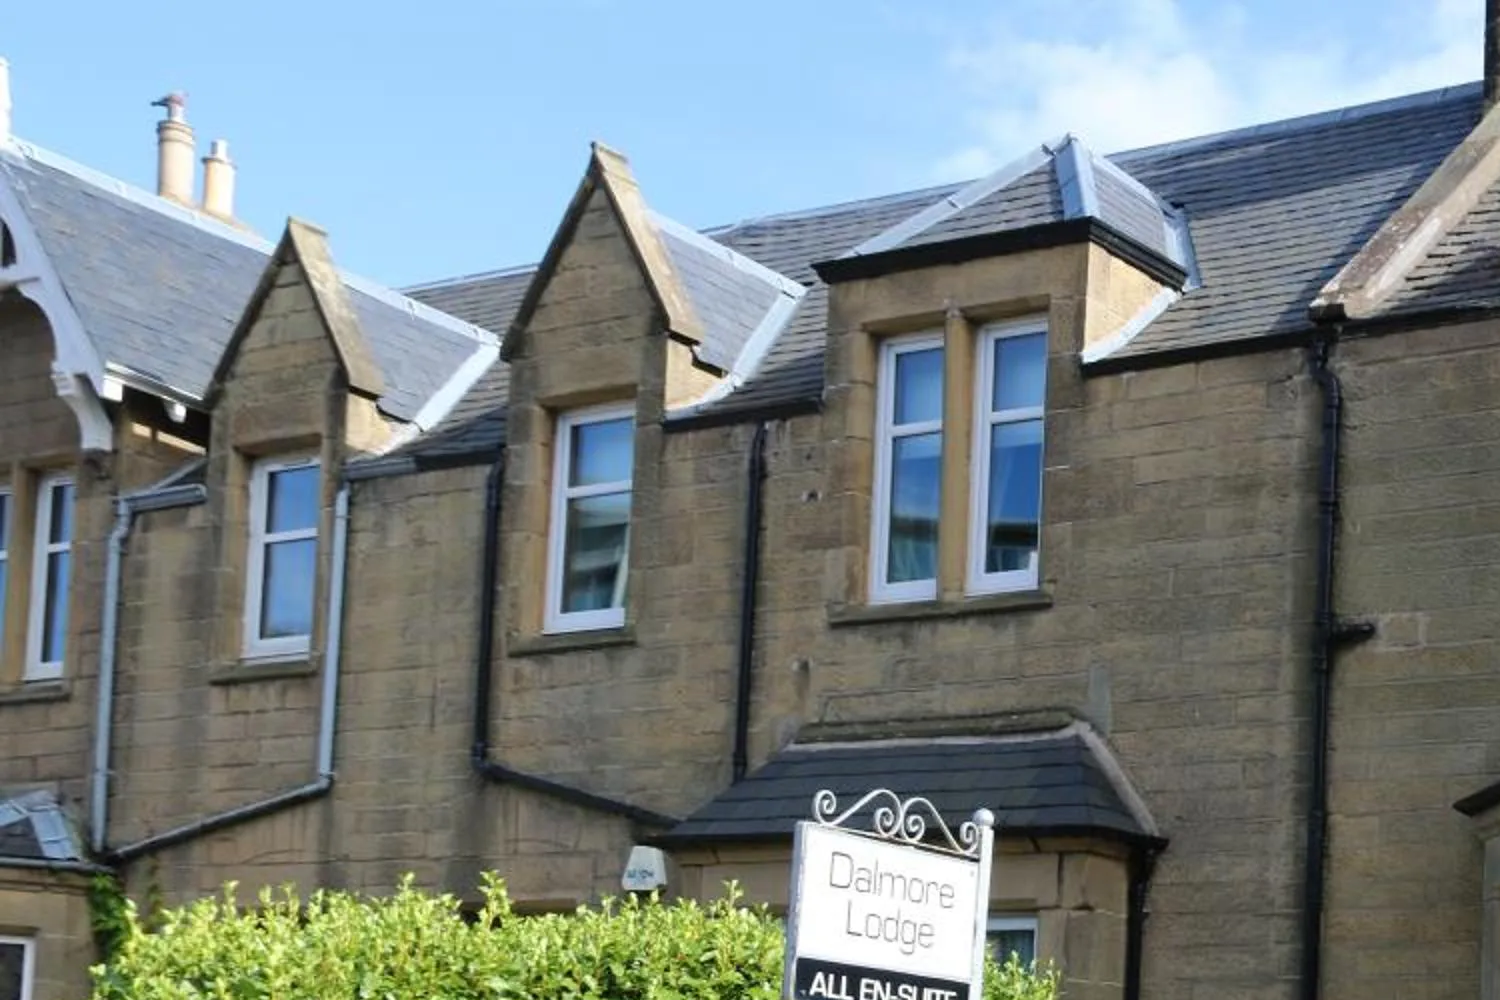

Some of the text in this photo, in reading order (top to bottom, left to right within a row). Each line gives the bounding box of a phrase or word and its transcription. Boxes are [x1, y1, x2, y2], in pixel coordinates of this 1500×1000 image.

[829, 851, 955, 908] Dalmore
[846, 900, 935, 955] Lodge
[809, 970, 854, 1000] ALL
